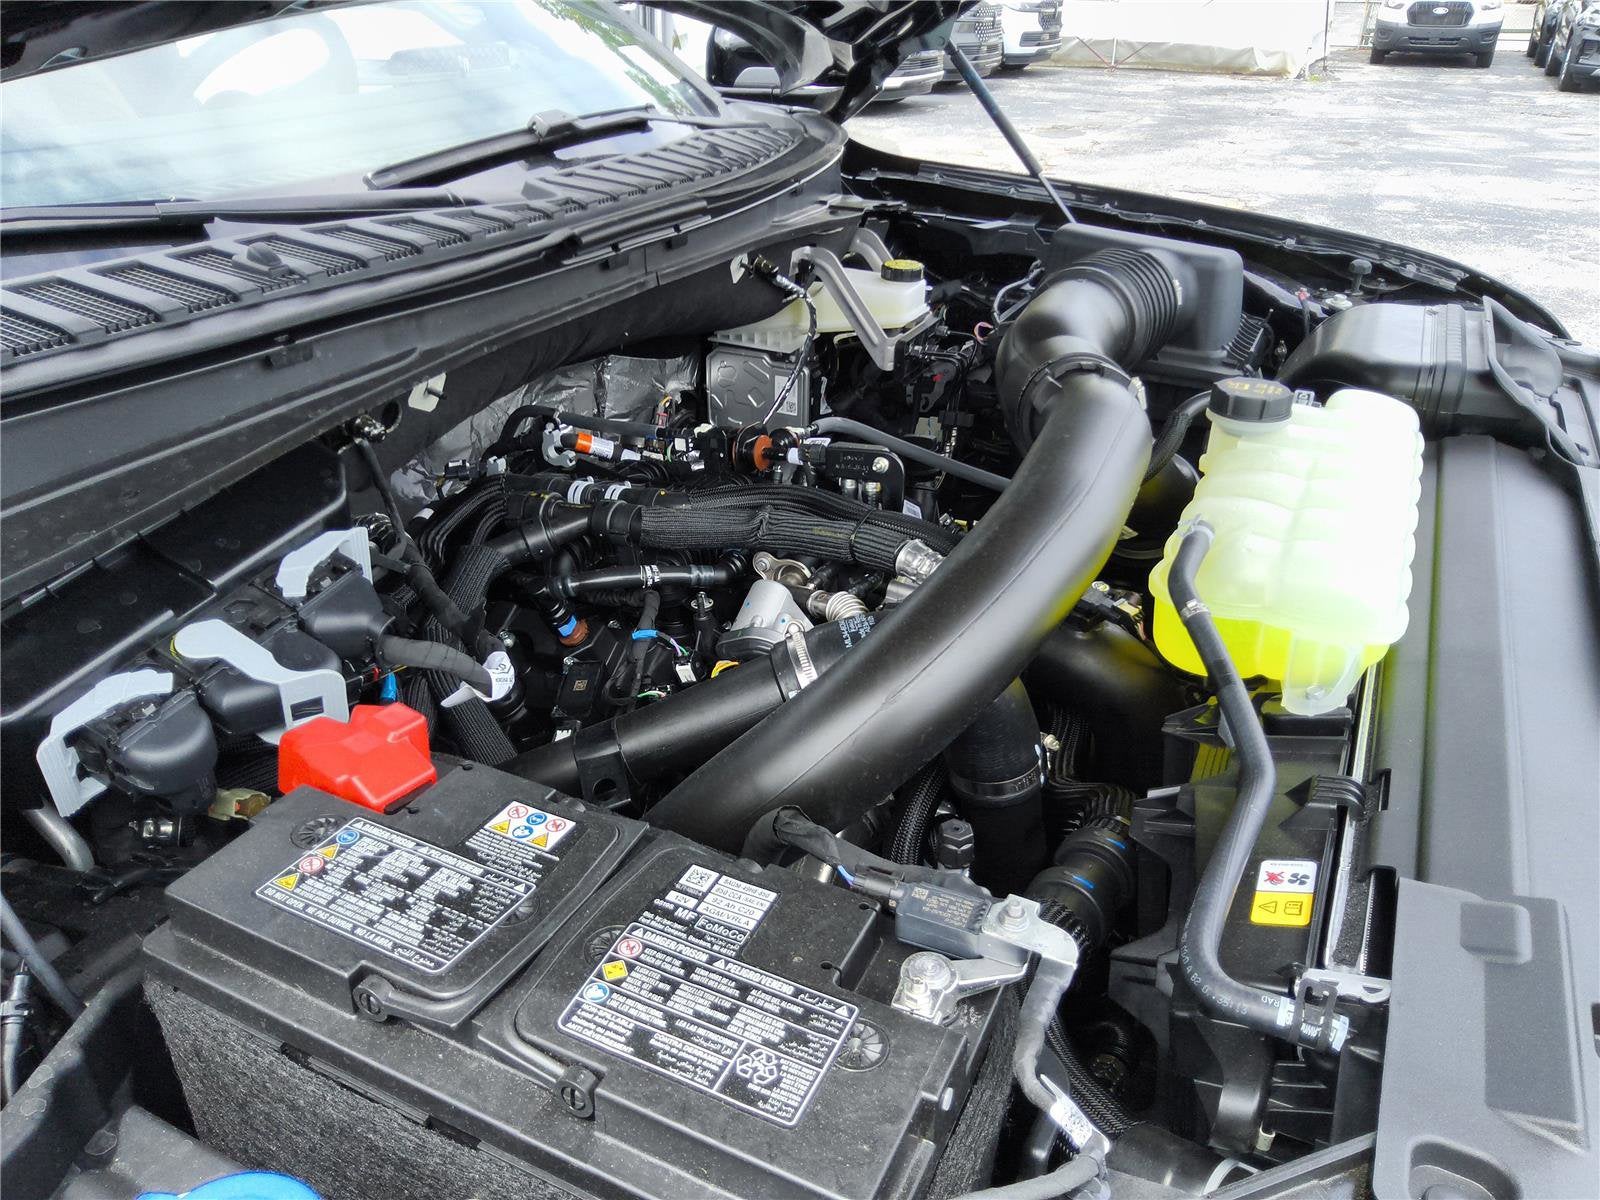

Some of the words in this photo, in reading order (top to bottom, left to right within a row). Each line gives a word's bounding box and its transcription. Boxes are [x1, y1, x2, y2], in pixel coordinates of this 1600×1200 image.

[674, 895, 689, 903] 12V
[724, 901, 736, 909] Ah
[673, 907, 697, 921] MF
[698, 919, 745, 940] FoMoCo
[642, 931, 708, 961] DANGER/POISON
[724, 962, 794, 994] PELIGRO/VENENO
